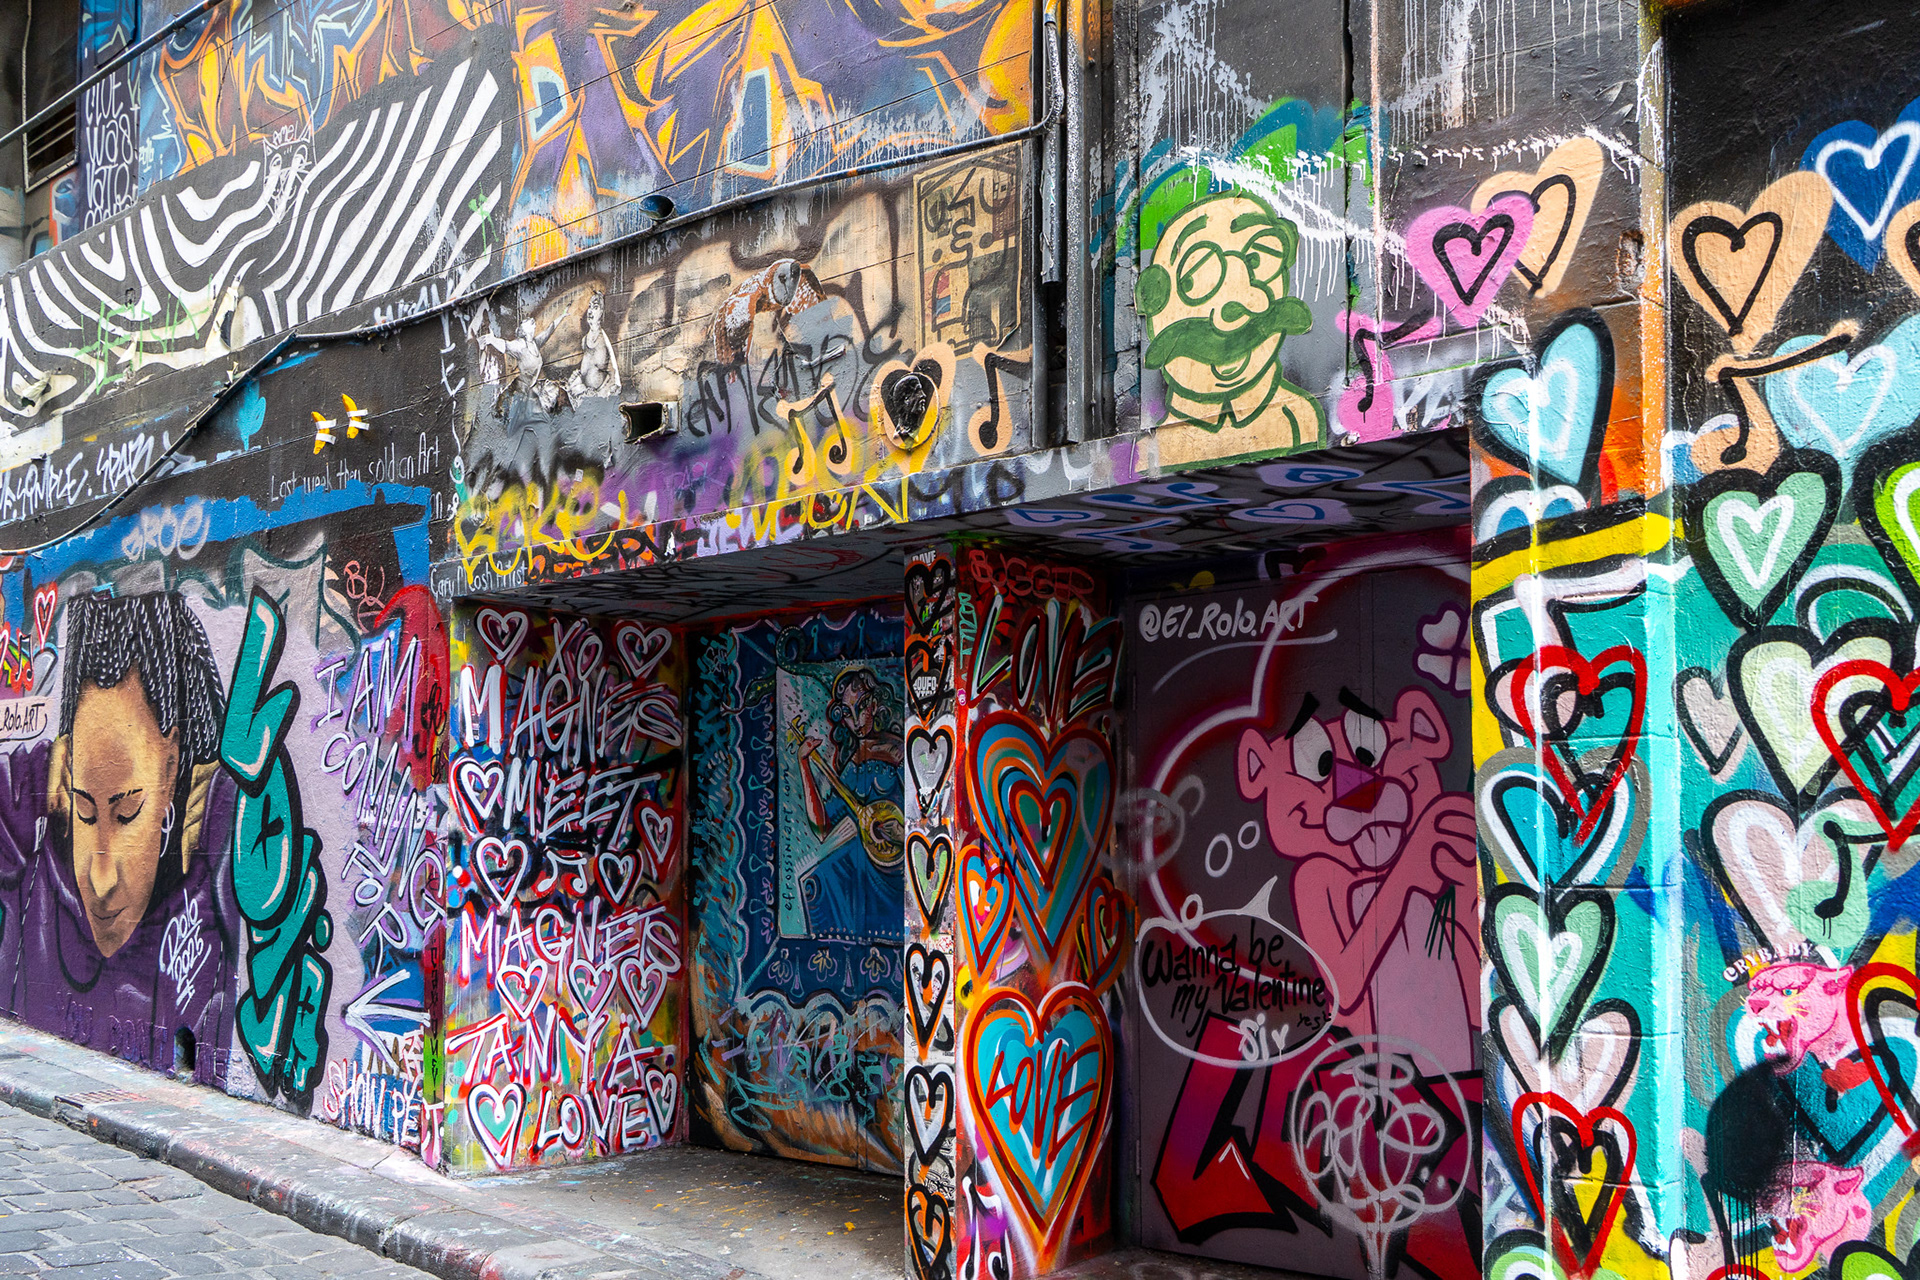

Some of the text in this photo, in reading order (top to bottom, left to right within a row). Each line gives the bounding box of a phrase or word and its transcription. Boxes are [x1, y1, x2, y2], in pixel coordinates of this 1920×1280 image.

[271, 470, 297, 502] Last
[303, 462, 332, 494] week
[368, 442, 395, 486] sold
[417, 431, 440, 476] Art
[966, 592, 1124, 732] LOVE
[503, 757, 662, 849] MEET
[1141, 918, 1284, 988] Wanna be
[1722, 942, 1823, 982] CRYBABY
[1170, 960, 1326, 1038] my Valentine
[534, 1086, 655, 1157] LOVE
[985, 1037, 1101, 1165] LOVE
